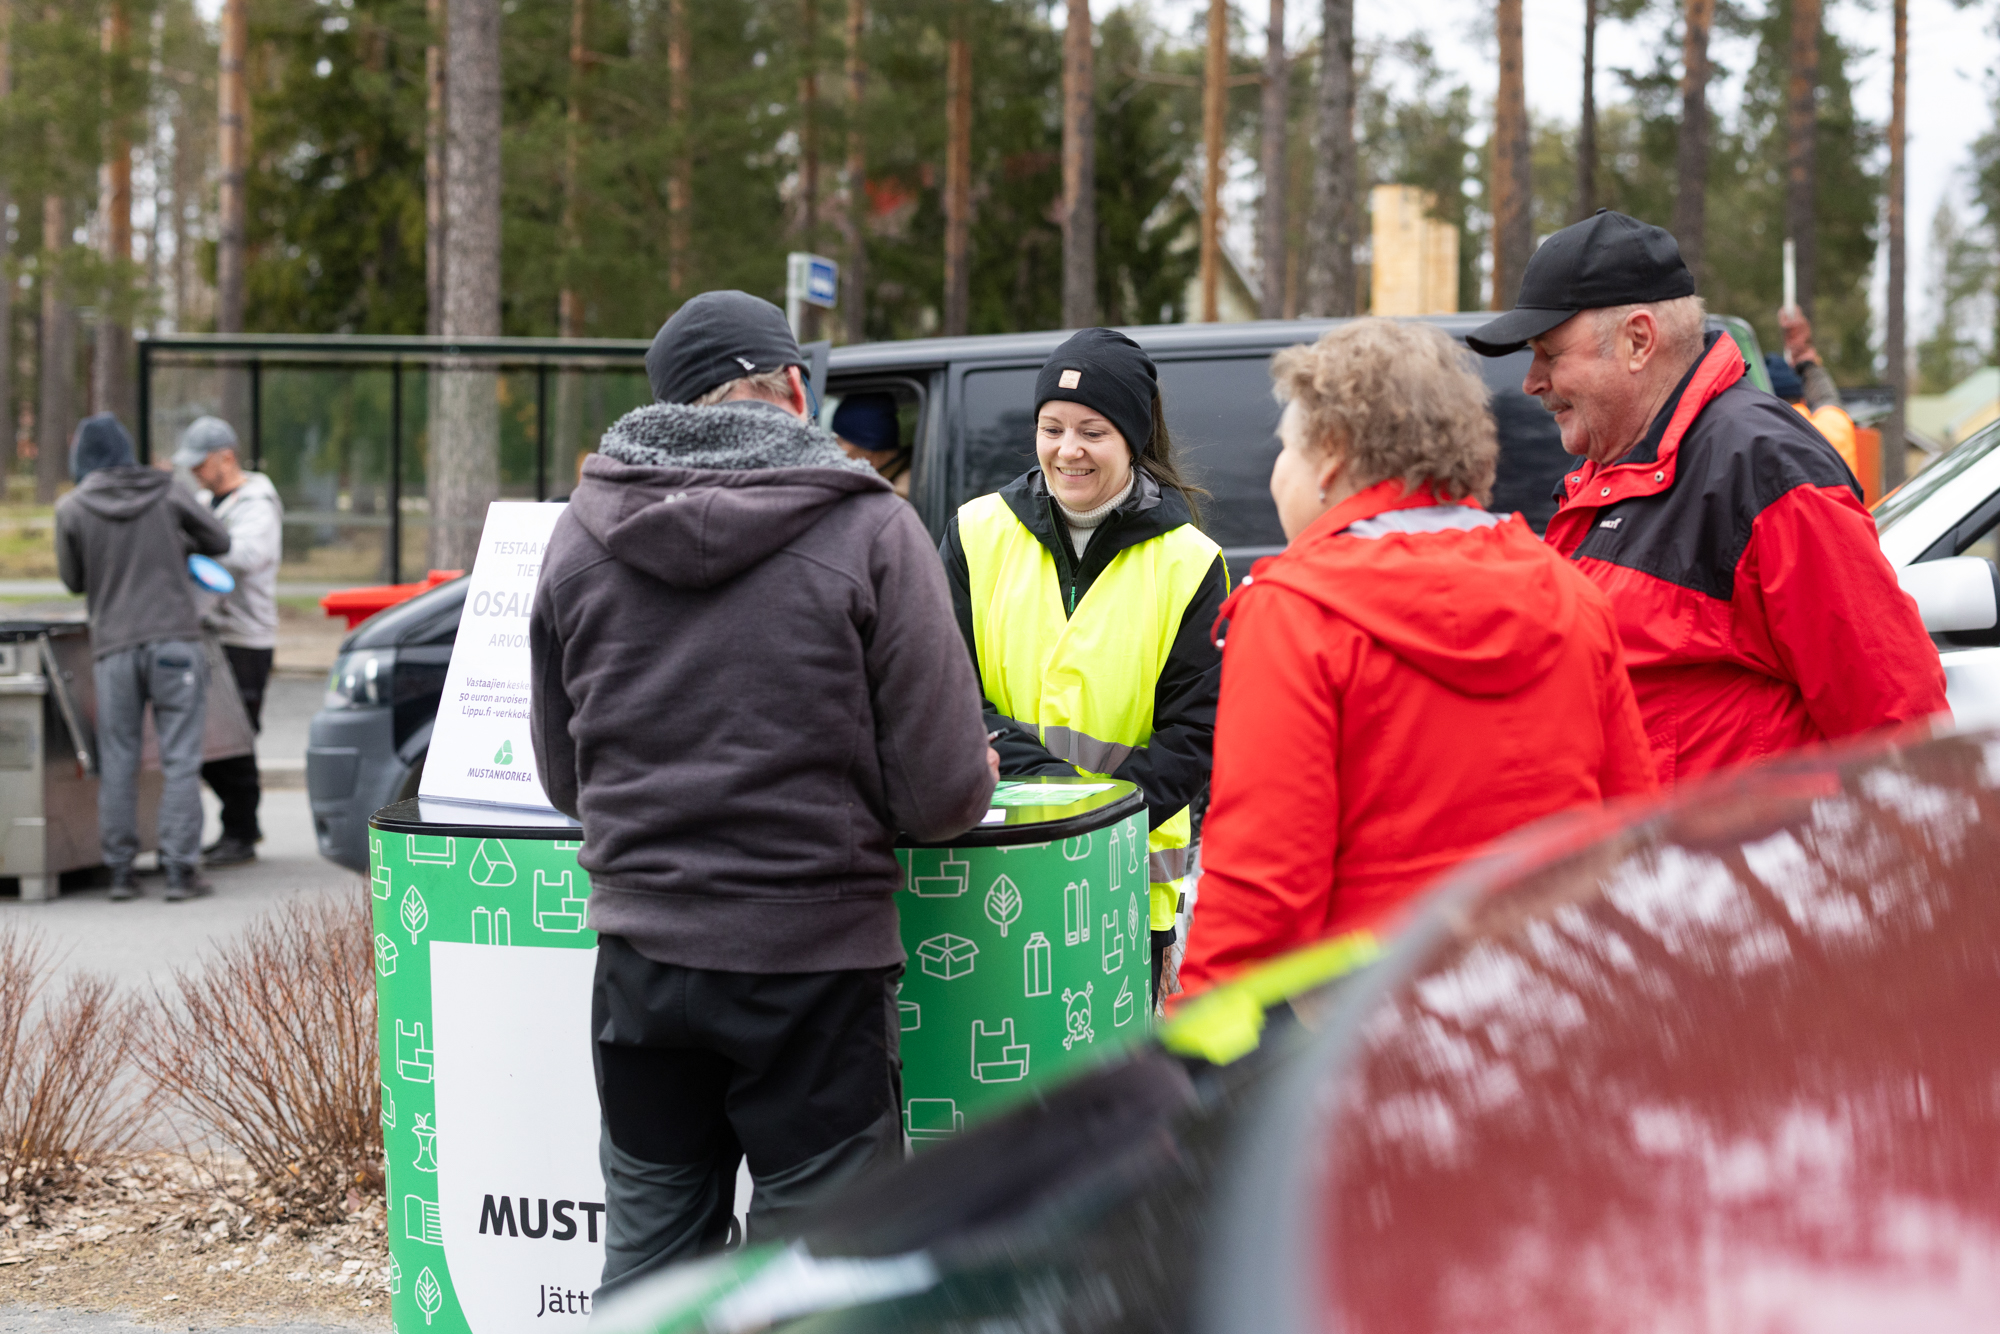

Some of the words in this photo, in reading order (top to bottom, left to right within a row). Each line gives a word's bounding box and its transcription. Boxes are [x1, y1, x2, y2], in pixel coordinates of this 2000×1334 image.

[494, 541, 537, 555] TESTAA
[517, 564, 542, 578] TIET
[472, 590, 531, 618] OSAL
[466, 677, 506, 690] Vastaajien
[507, 680, 532, 690] keske
[459, 692, 470, 702] 50
[470, 694, 494, 702] euron
[494, 693, 528, 704] arvoisen
[462, 705, 492, 718] Lippu.fi
[467, 767, 532, 782] MUSTANKORKEA
[478, 1193, 606, 1243] MUST
[536, 1284, 594, 1318] Jätt
